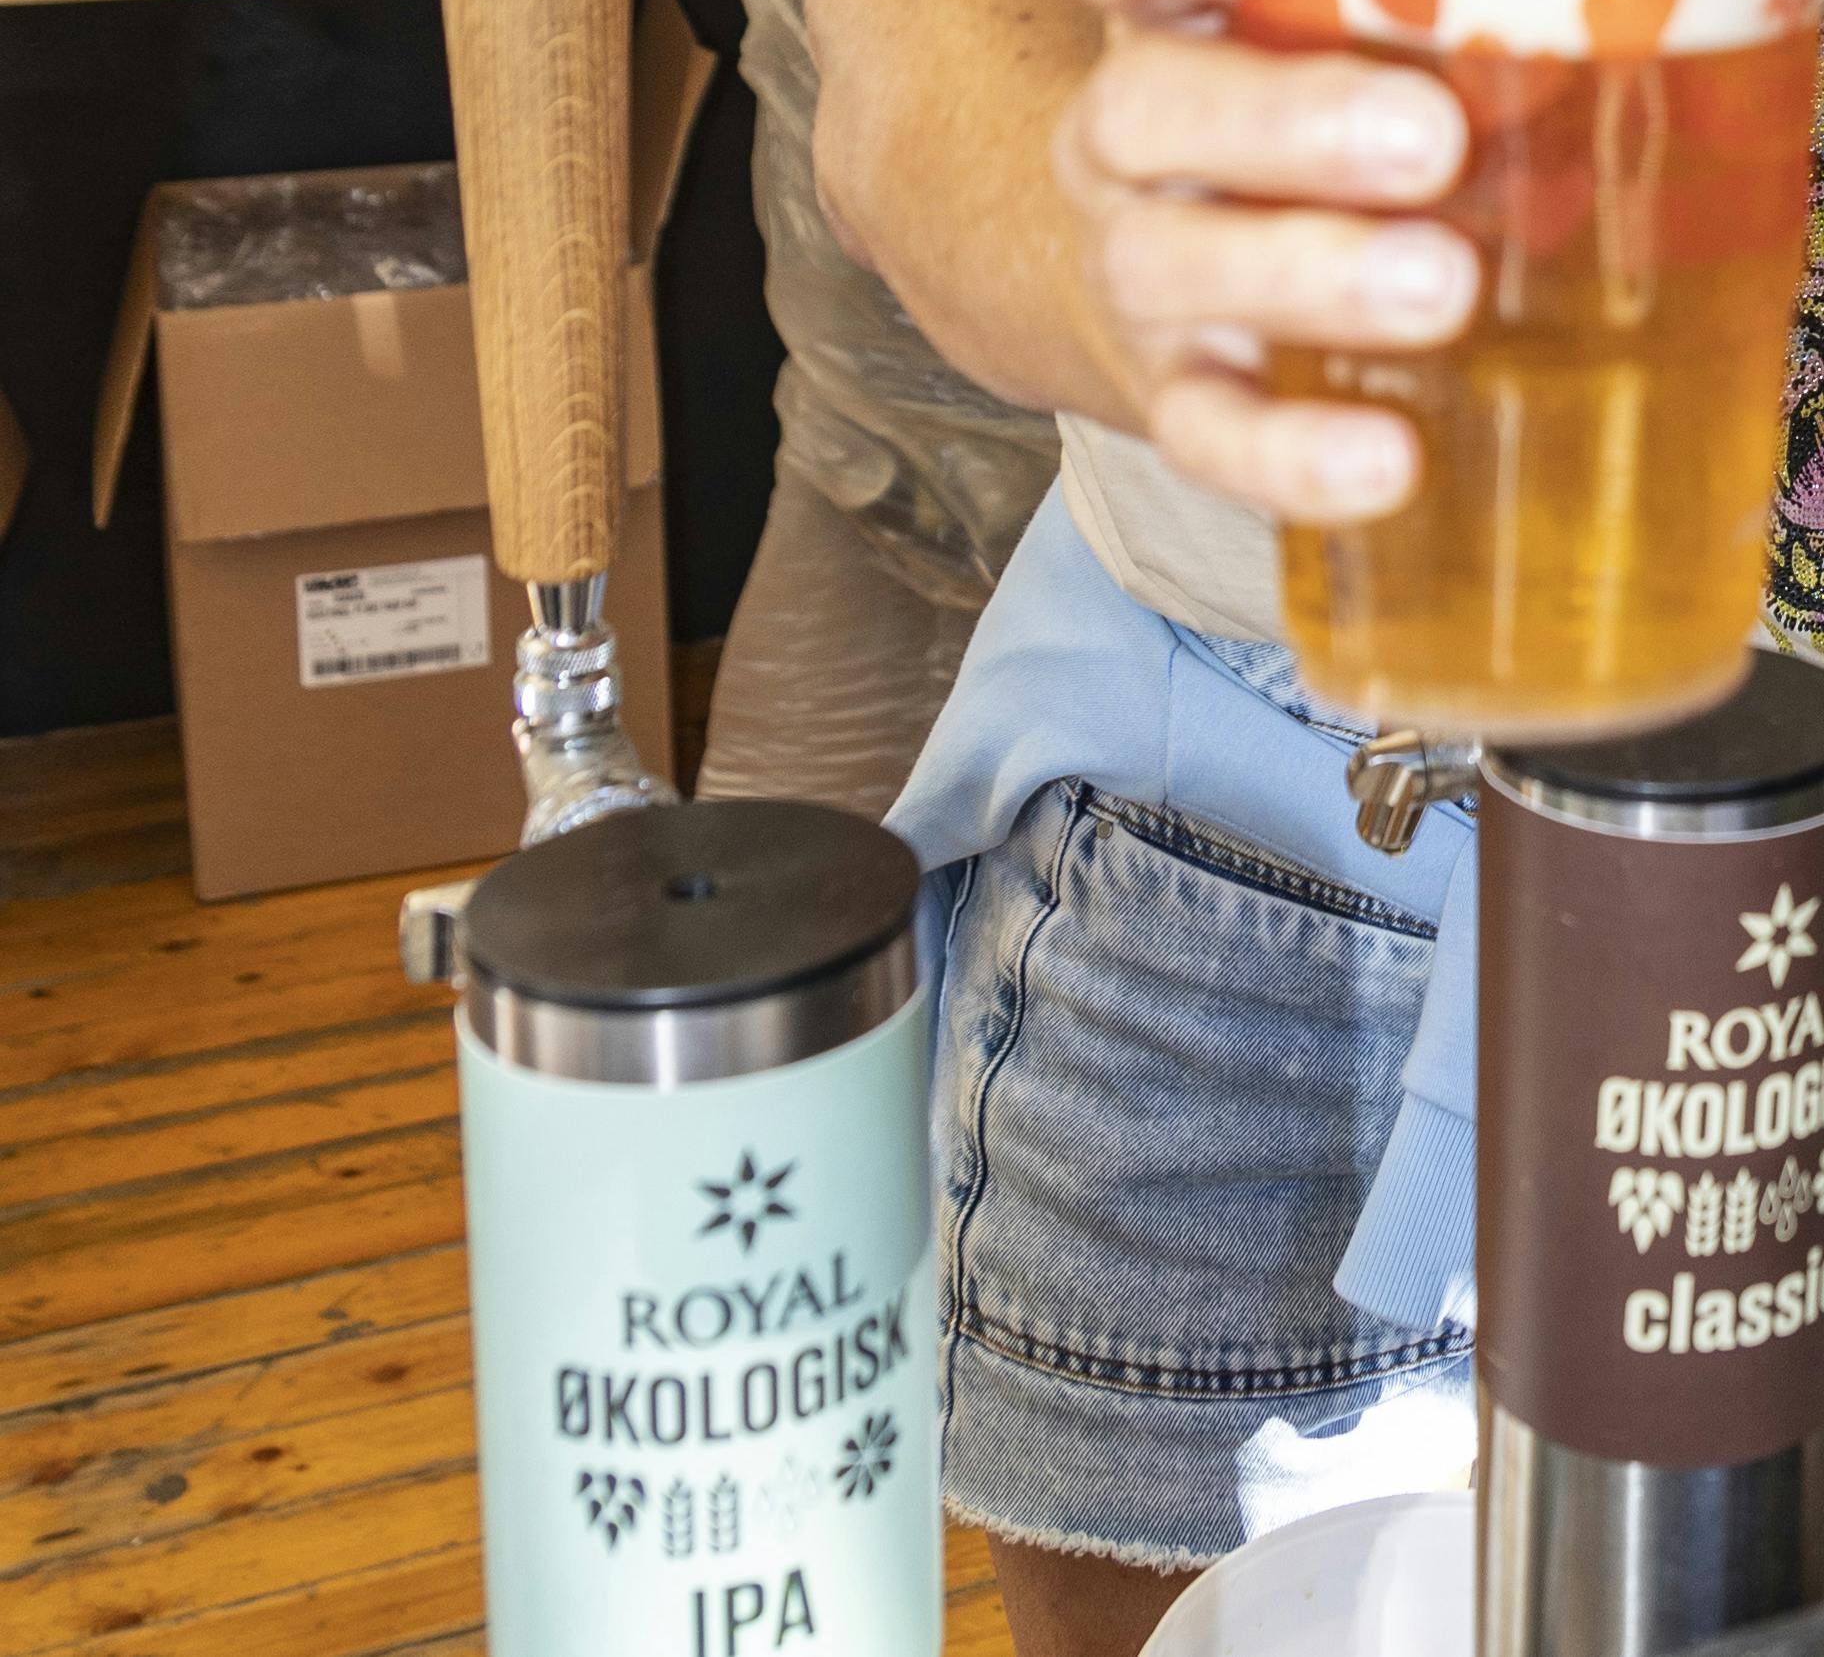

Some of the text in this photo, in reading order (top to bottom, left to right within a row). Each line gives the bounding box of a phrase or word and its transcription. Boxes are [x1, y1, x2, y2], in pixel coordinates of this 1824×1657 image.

[621, 1249, 865, 1349] ROYAL
[556, 1287, 911, 1446] ØKOLOGISK
[691, 1568, 816, 1657] IPA
